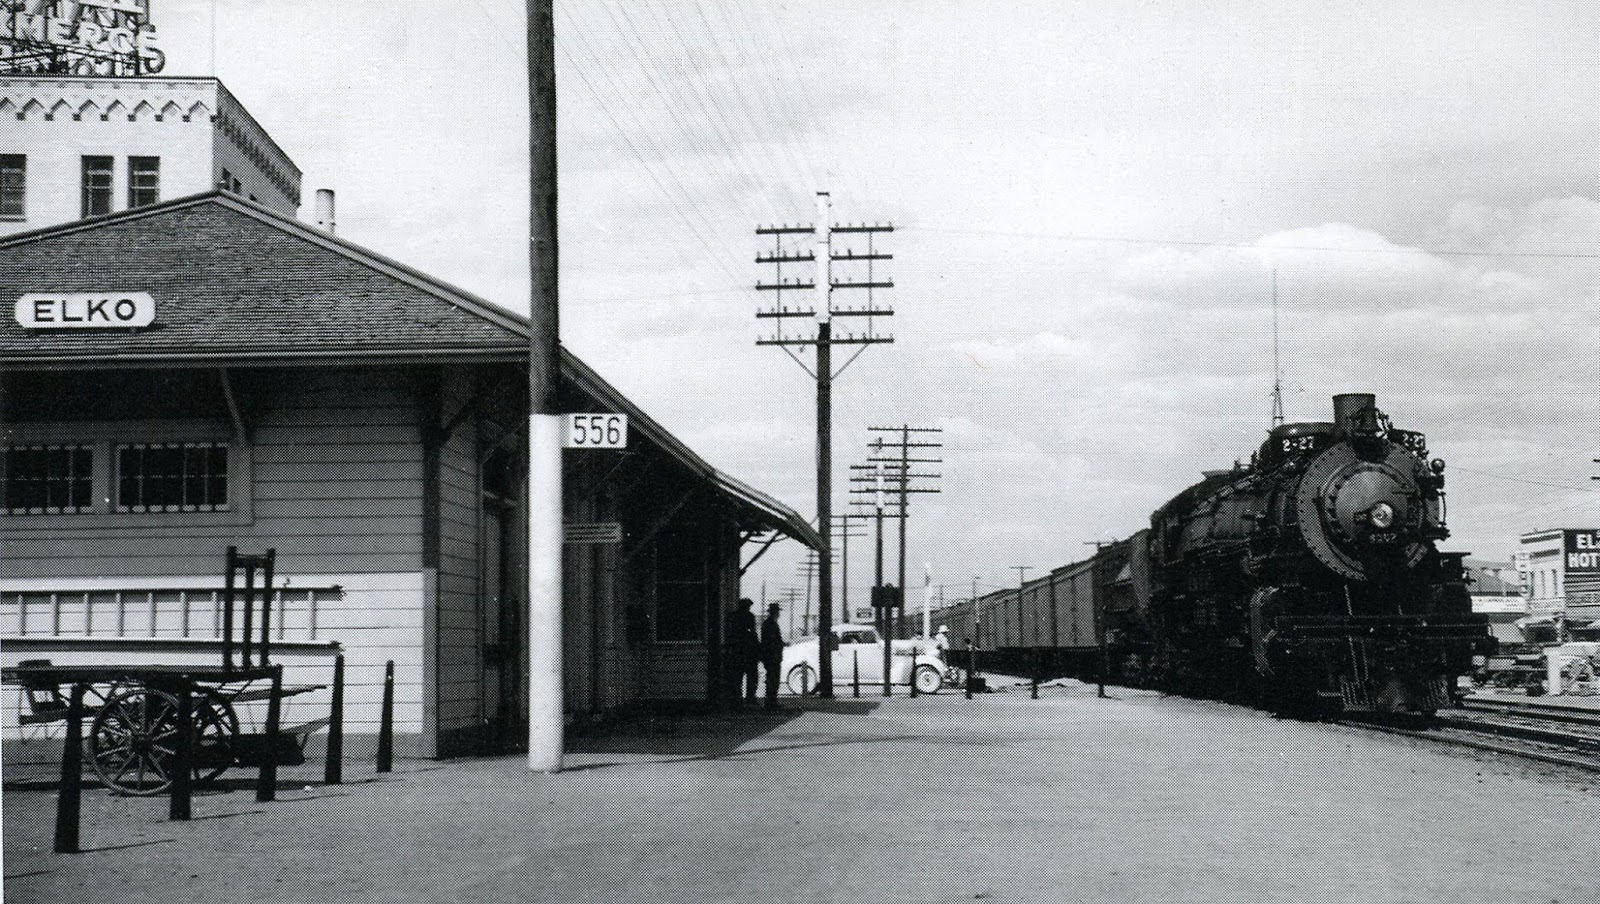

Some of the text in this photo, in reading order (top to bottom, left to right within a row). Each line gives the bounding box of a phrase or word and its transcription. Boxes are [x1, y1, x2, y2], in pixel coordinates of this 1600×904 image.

[33, 299, 136, 322] ELKO
[573, 415, 620, 445] 556
[1282, 435, 1315, 452] 2-27
[1576, 533, 1600, 549] EL
